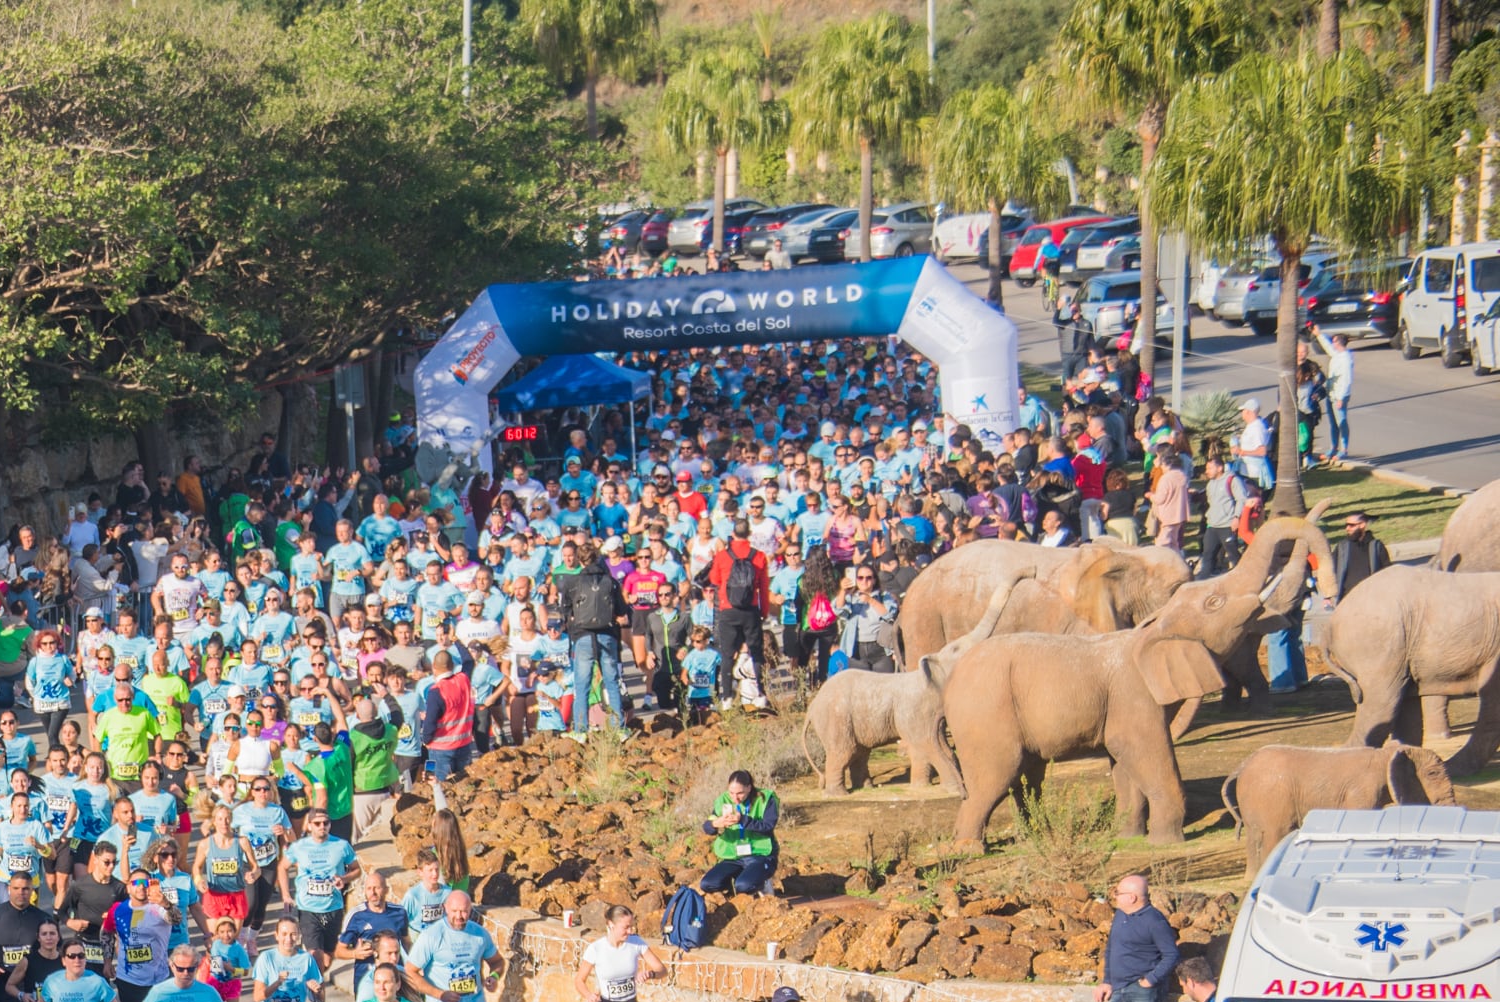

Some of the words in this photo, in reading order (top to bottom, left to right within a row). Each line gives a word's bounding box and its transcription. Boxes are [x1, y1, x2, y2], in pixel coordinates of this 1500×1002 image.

[551, 298, 680, 323] HOLIDAY
[748, 283, 863, 311] WORLD
[623, 325, 677, 339] Resort
[680, 321, 730, 336] Costa
[735, 318, 761, 332] del
[764, 315, 791, 330] Sol
[128, 949, 150, 960] 1364
[451, 981, 474, 991] 1457
[610, 982, 633, 994] 2399
